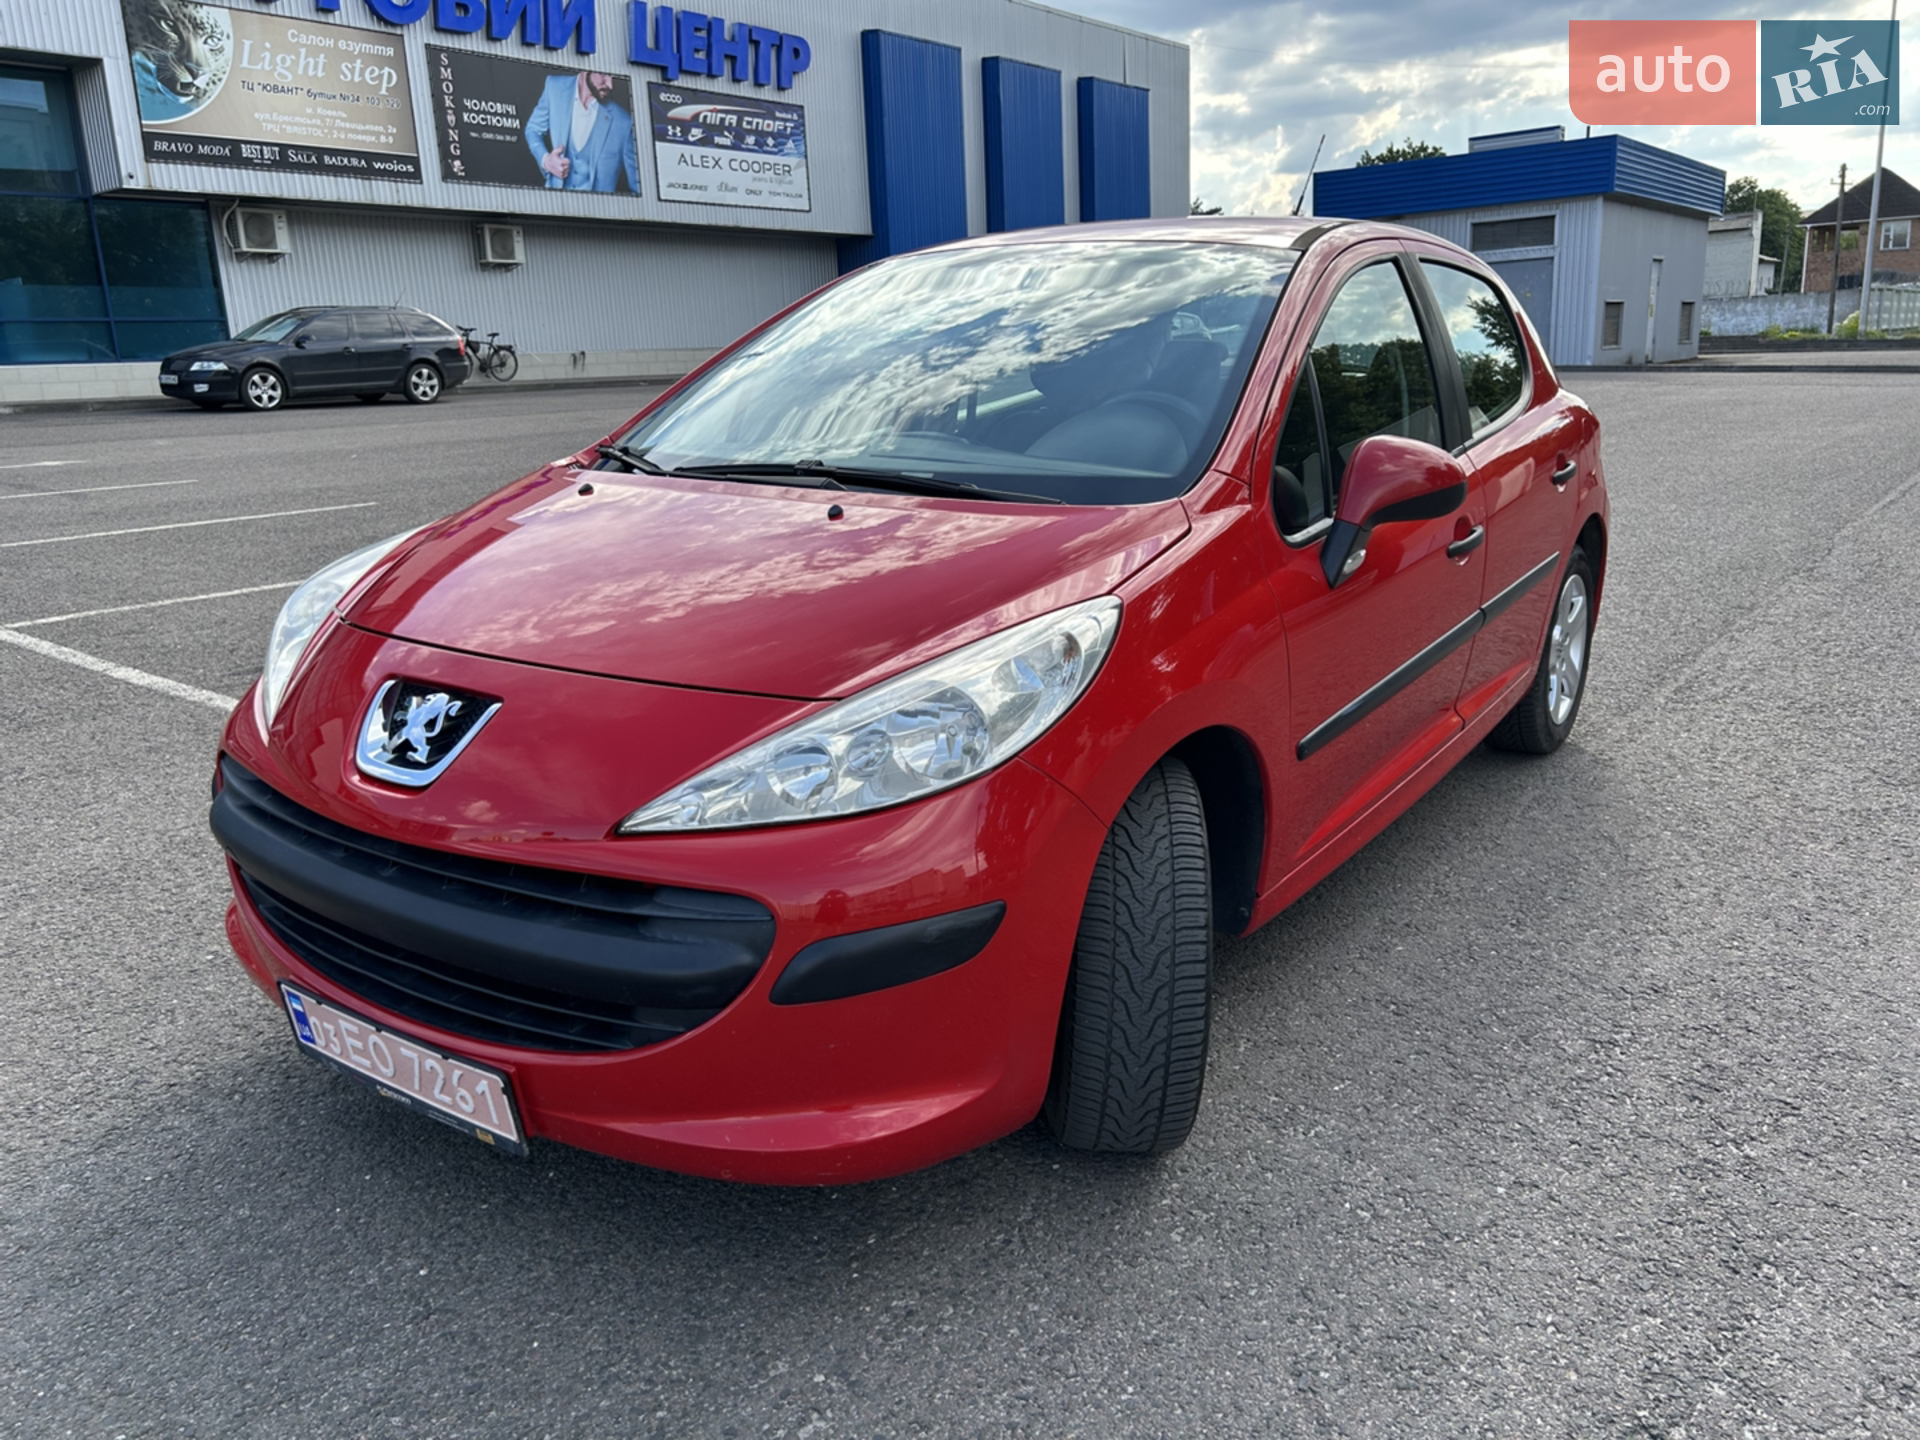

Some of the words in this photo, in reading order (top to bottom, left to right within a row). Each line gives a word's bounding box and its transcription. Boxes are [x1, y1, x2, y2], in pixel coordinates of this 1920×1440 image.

[287, 29, 334, 48] Салон
[338, 39, 394, 57] взуття
[627, 0, 811, 90] ЦЕНТР
[239, 38, 328, 82] Light
[339, 58, 398, 95] step
[241, 80, 255, 92] ТЦ
[306, 87, 337, 101] бутик
[659, 92, 683, 104] ecco
[463, 98, 517, 116] ЧОЛОВІЧІ
[463, 112, 521, 129] КОСТЮМИ
[742, 116, 794, 135] СПОРТ
[153, 140, 193, 153] BRAVO
[196, 144, 232, 157] MODA
[241, 144, 261, 159] BEST
[263, 146, 280, 161] BUT
[323, 155, 367, 169] BADURA
[372, 160, 415, 173] wojas
[677, 152, 723, 170] ALEX
[729, 158, 793, 176] COOPER
[745, 188, 763, 197] ONLY
